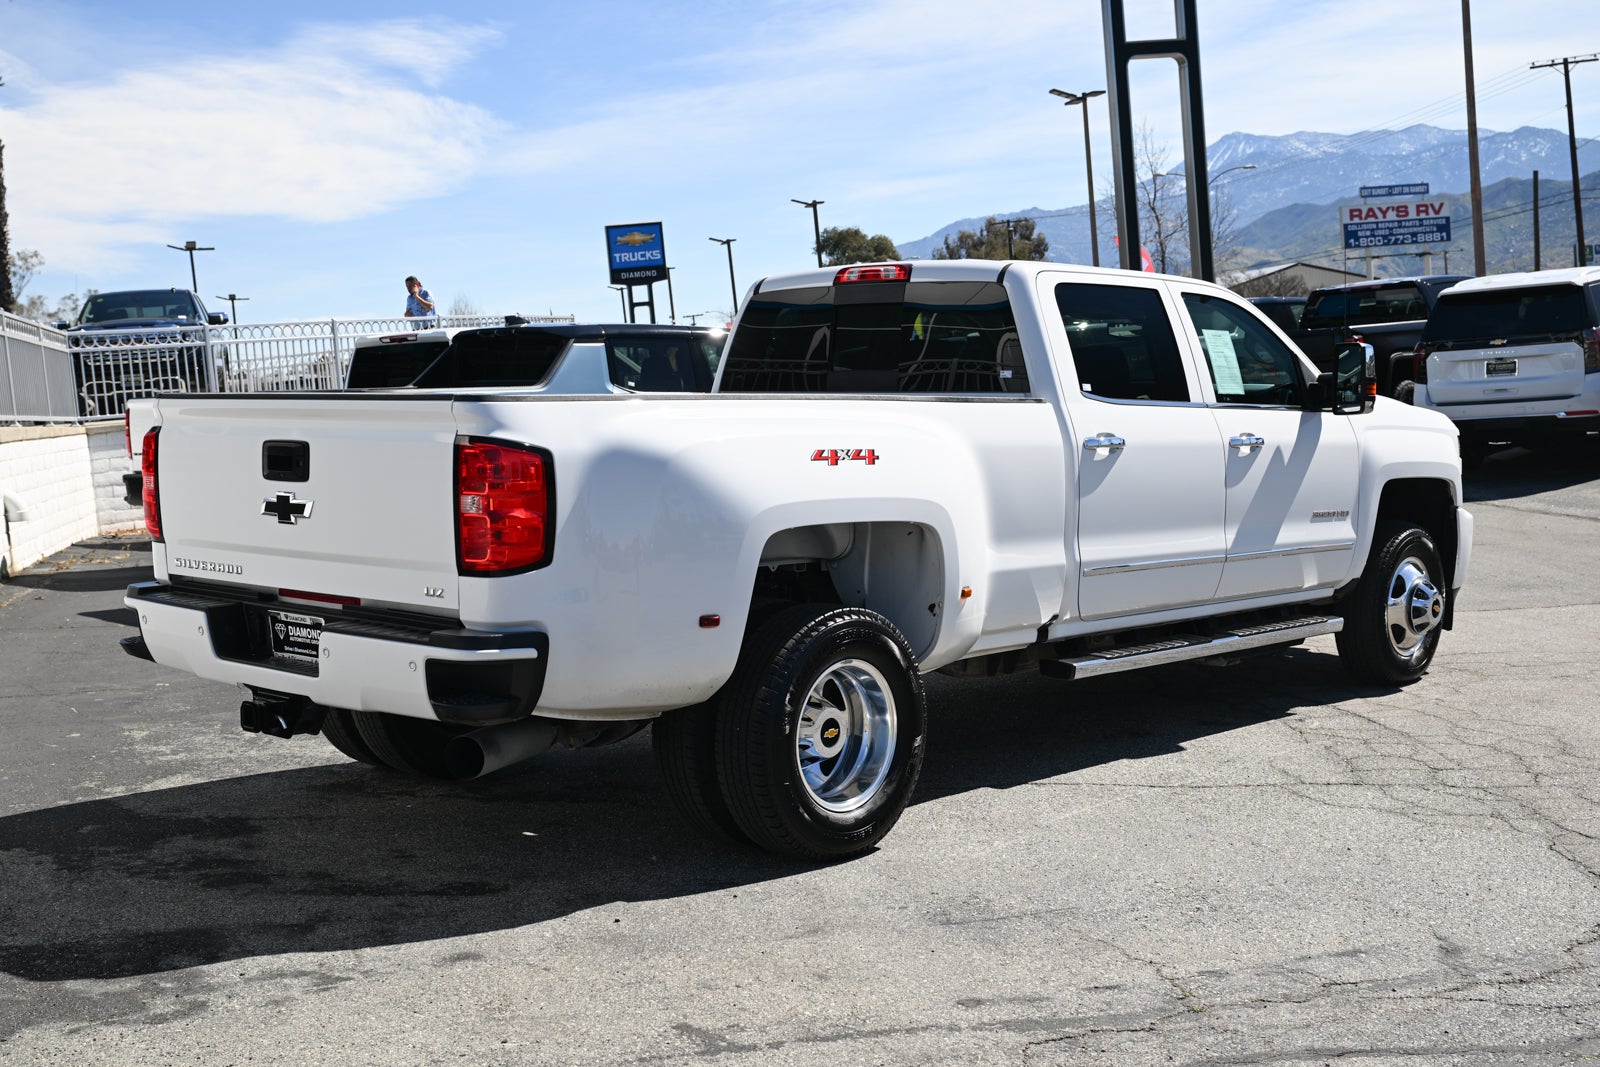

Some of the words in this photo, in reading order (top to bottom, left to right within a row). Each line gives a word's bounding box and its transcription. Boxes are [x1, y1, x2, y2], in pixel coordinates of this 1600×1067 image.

[1349, 205, 1409, 221] RAY'S
[1416, 202, 1445, 217] RV
[1347, 223, 1377, 231] COLLISION
[613, 250, 661, 263] TRUCKS
[621, 270, 657, 279] DIAMOND
[174, 557, 243, 575] SILVERADO
